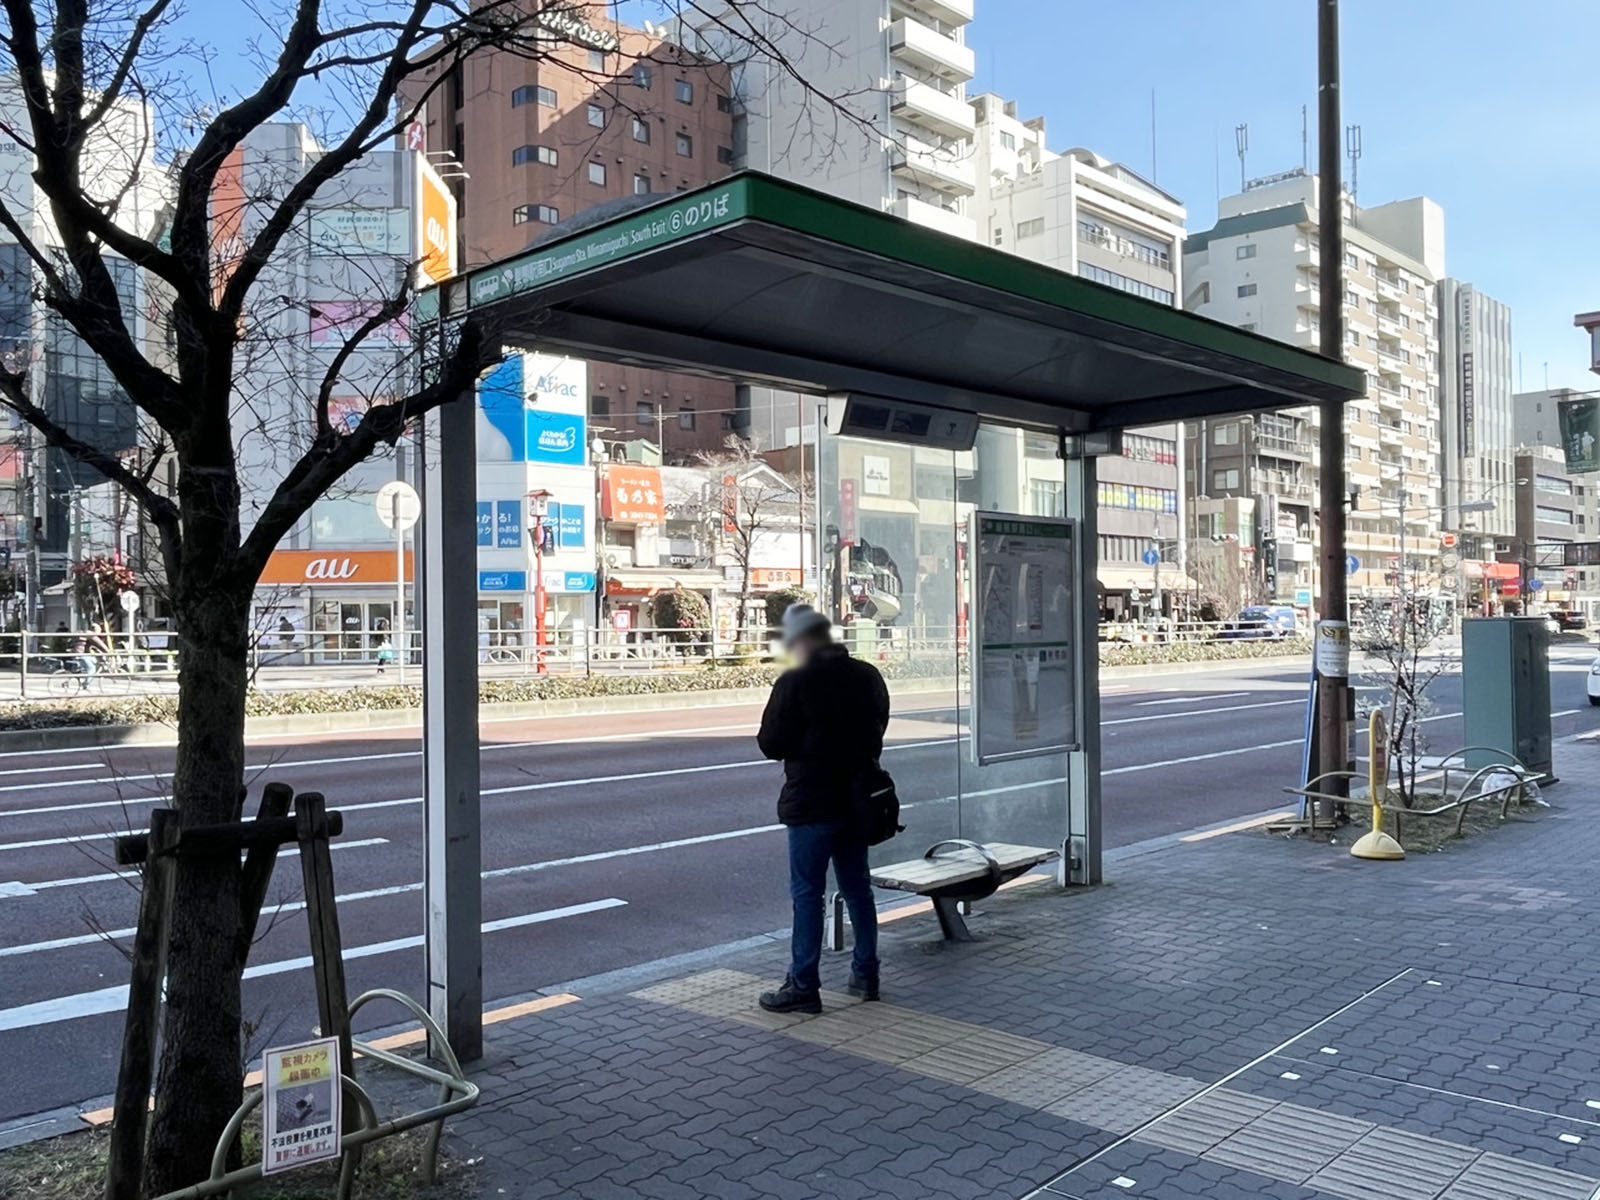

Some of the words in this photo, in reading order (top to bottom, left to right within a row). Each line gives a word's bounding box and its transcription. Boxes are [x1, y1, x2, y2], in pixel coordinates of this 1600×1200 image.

[305, 557, 359, 579] au
[345, 616, 360, 624] au
[281, 1049, 328, 1069] 監視カメラ
